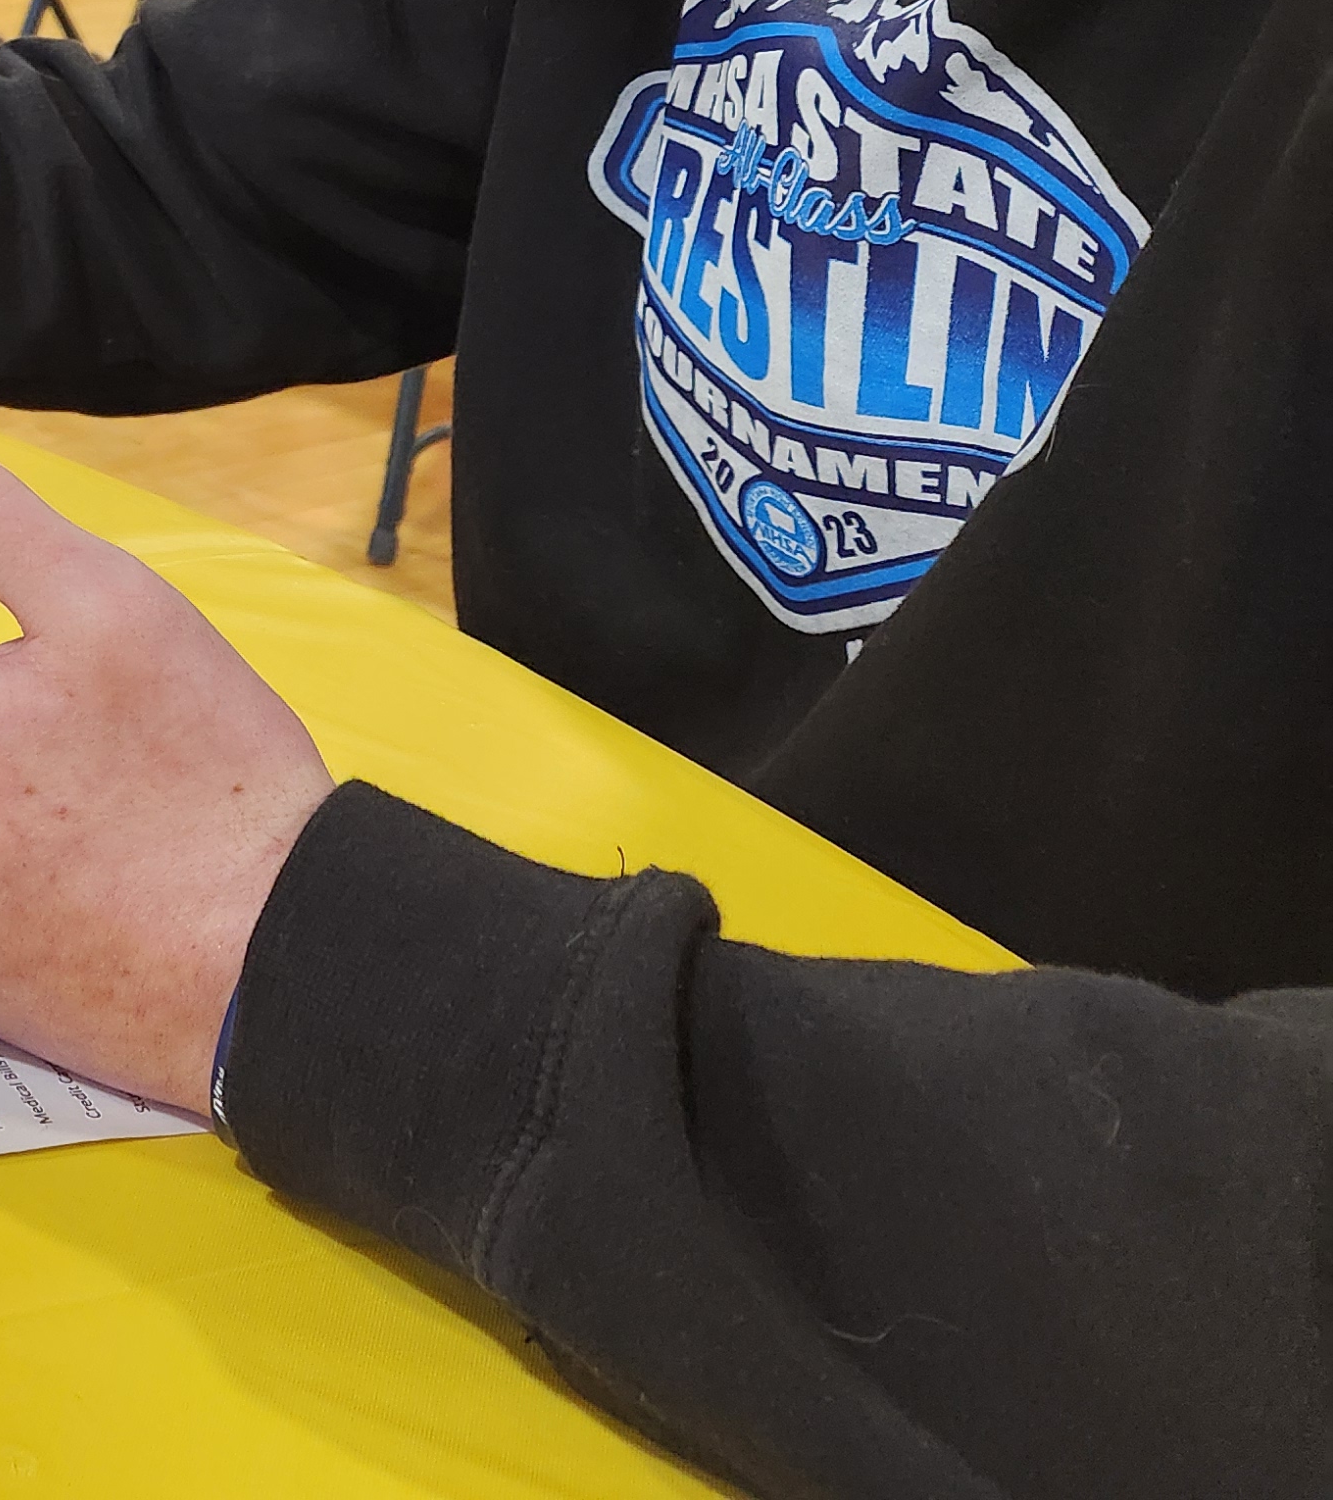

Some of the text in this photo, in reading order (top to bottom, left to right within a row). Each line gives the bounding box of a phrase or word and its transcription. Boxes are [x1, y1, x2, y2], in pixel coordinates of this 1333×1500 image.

[717, 118, 919, 246] All-Class
[791, 68, 1099, 283] STATE
[700, 437, 735, 494] 20
[823, 511, 878, 560] 23
[9, 1082, 52, 1124] Medical
[68, 1085, 101, 1118] Credit
